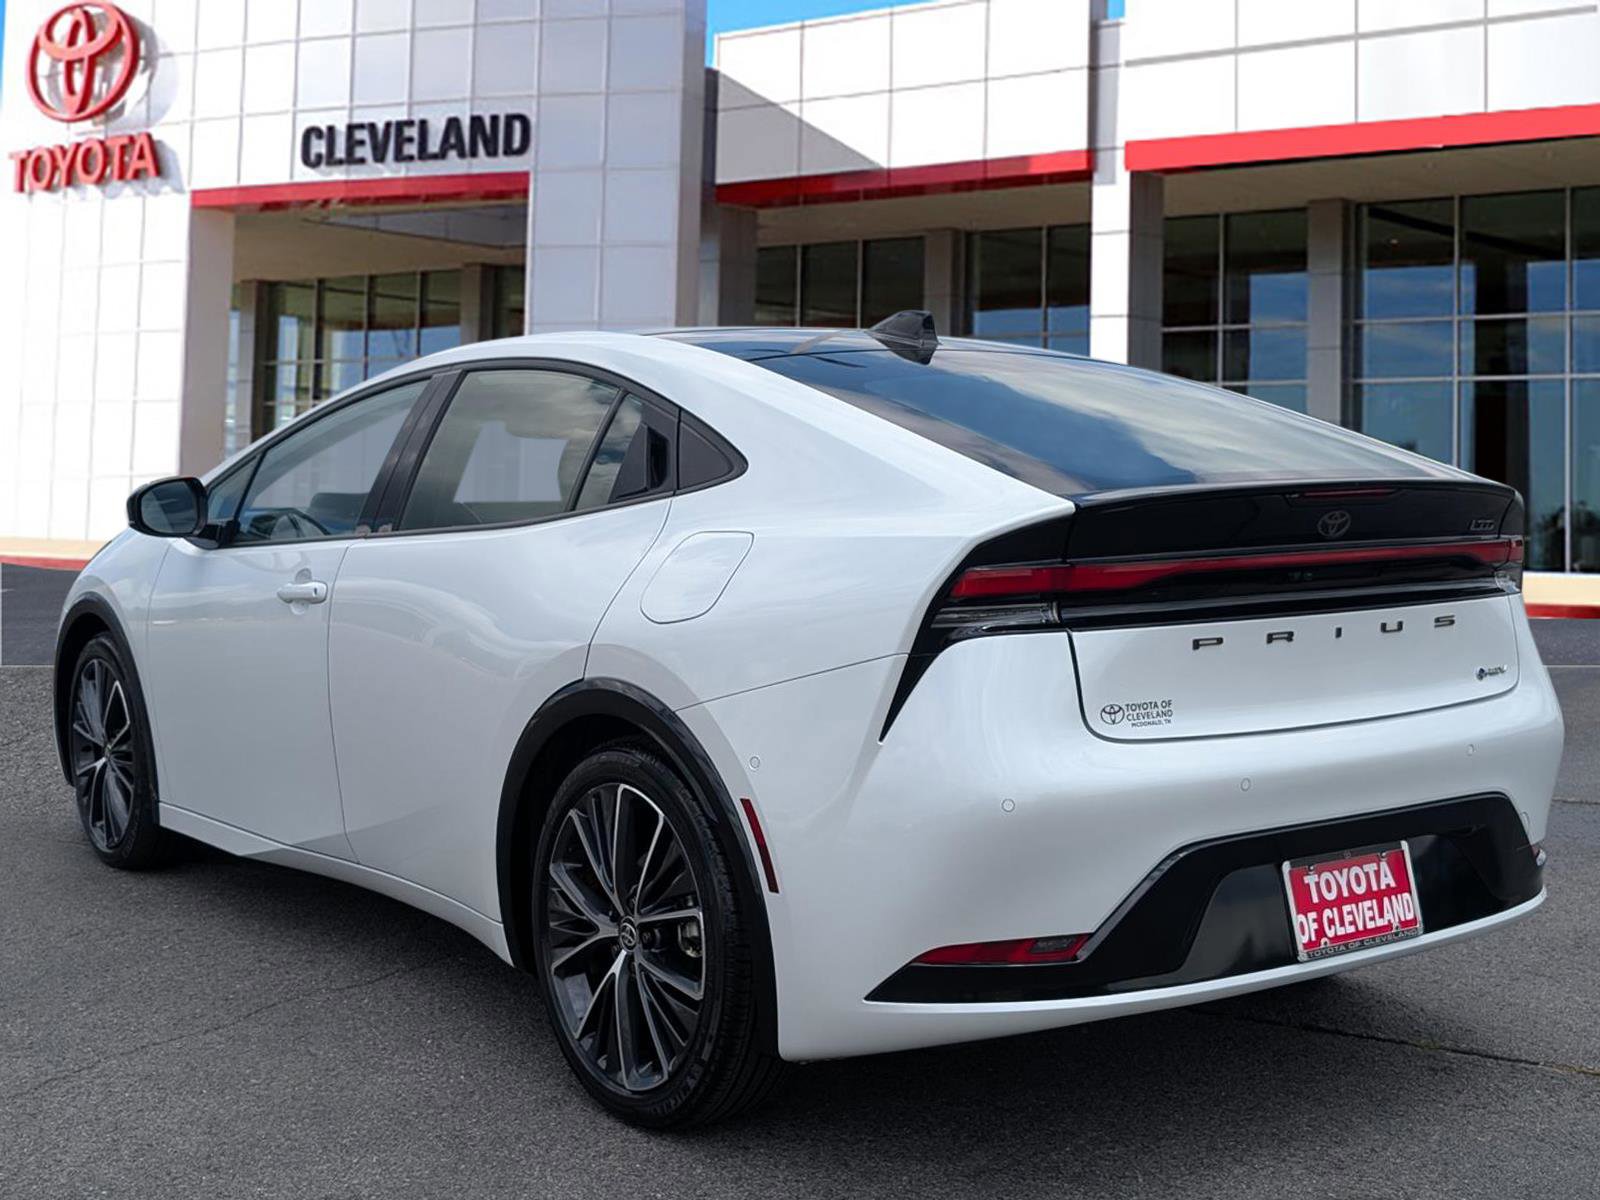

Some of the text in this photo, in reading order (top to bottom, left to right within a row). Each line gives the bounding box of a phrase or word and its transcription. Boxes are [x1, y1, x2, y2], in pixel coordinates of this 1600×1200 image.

[301, 113, 531, 169] CLEVELAND
[9, 132, 160, 193] TOYOTA
[1192, 614, 1456, 650] PRIUS
[1125, 699, 1173, 712] TOYOTA OF
[1126, 709, 1173, 721] CLEVELAND
[1303, 861, 1397, 903] TOYOTA
[1296, 892, 1415, 944] OF CLEVELAND
[1309, 929, 1418, 958] TOYOTA OF CLEVELAND
